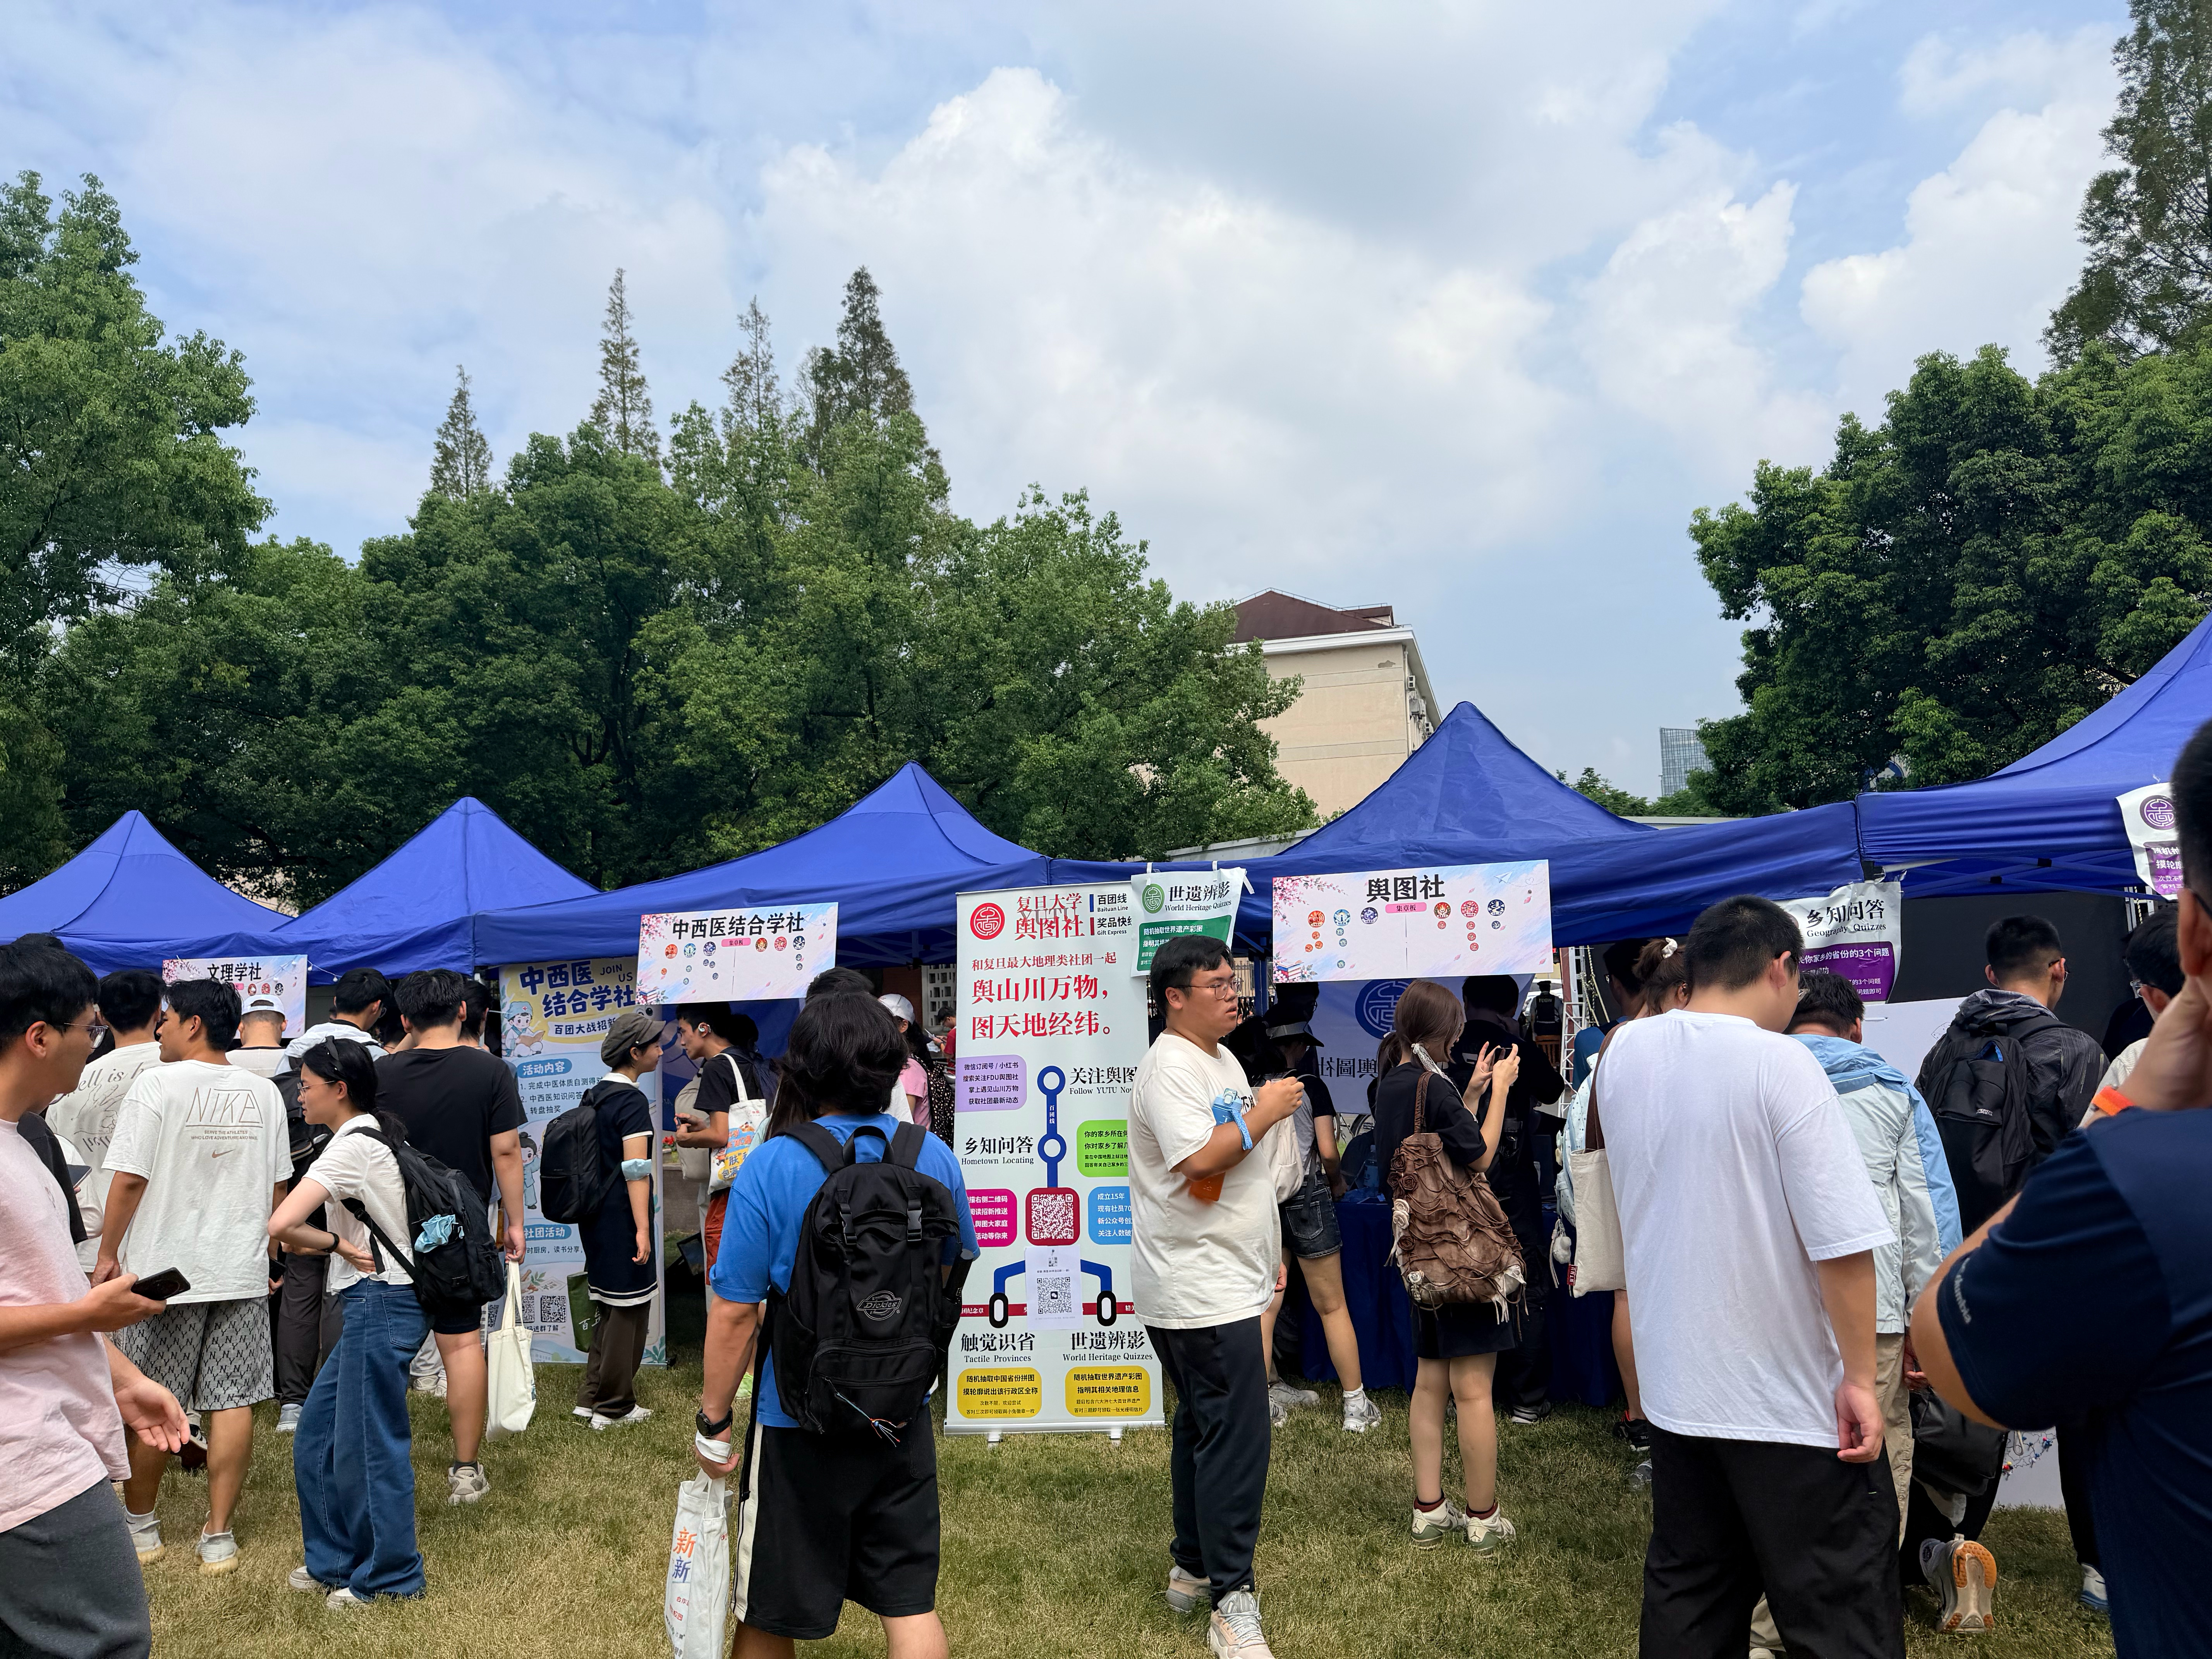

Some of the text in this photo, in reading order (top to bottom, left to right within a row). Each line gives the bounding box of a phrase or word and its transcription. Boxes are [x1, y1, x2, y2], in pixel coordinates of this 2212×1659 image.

[1168, 881, 1230, 902] 世遗辨影
[1367, 874, 1445, 903] 舆图社
[1017, 893, 1082, 913] 复旦大学
[1097, 893, 1127, 905] 百团线
[1213, 900, 1231, 909] Quizzes
[1807, 900, 1885, 928] 乡知问答
[673, 912, 804, 939] 中西医结合学社
[1015, 915, 1085, 940] 舆图社
[1144, 925, 1203, 935] 随机抽取世界遗产彩图
[1807, 923, 1886, 938] Geography Quizzes
[600, 964, 622, 975] JOIN
[971, 952, 1117, 971] 和复旦最大地理类社团一起
[207, 962, 262, 981] 文理学社
[520, 960, 594, 995] 中西医
[618, 972, 633, 982] US
[972, 974, 1108, 1004] 舆山川万物，
[542, 985, 635, 1018] 结合学社
[972, 1010, 1110, 1040] 图天地经纬。
[107, 1069, 124, 1082] is
[523, 1061, 565, 1075] 活动内容
[186, 1087, 263, 1124] NIKE
[530, 1105, 561, 1114] 转盘抽奖
[963, 1136, 1034, 1155] 乡知问答
[524, 1227, 565, 1238] 社团活动
[864, 1300, 898, 1309] Dickies
[960, 1332, 1035, 1352] 触觉识省
[1070, 1330, 1145, 1350] 世遗辨影
[1063, 1352, 1152, 1361] World Heritage Quizzes
[967, 1374, 1034, 1382] 随机抽取中国省份拼图
[1074, 1373, 1142, 1381] 随机抽取世界遗产彩图
[963, 1387, 1038, 1395] 摸轮廓说出该行政区全称
[1077, 1386, 1139, 1394] 指明其相关地理信息
[673, 1526, 697, 1558] 新
[672, 1556, 691, 1583] 新
